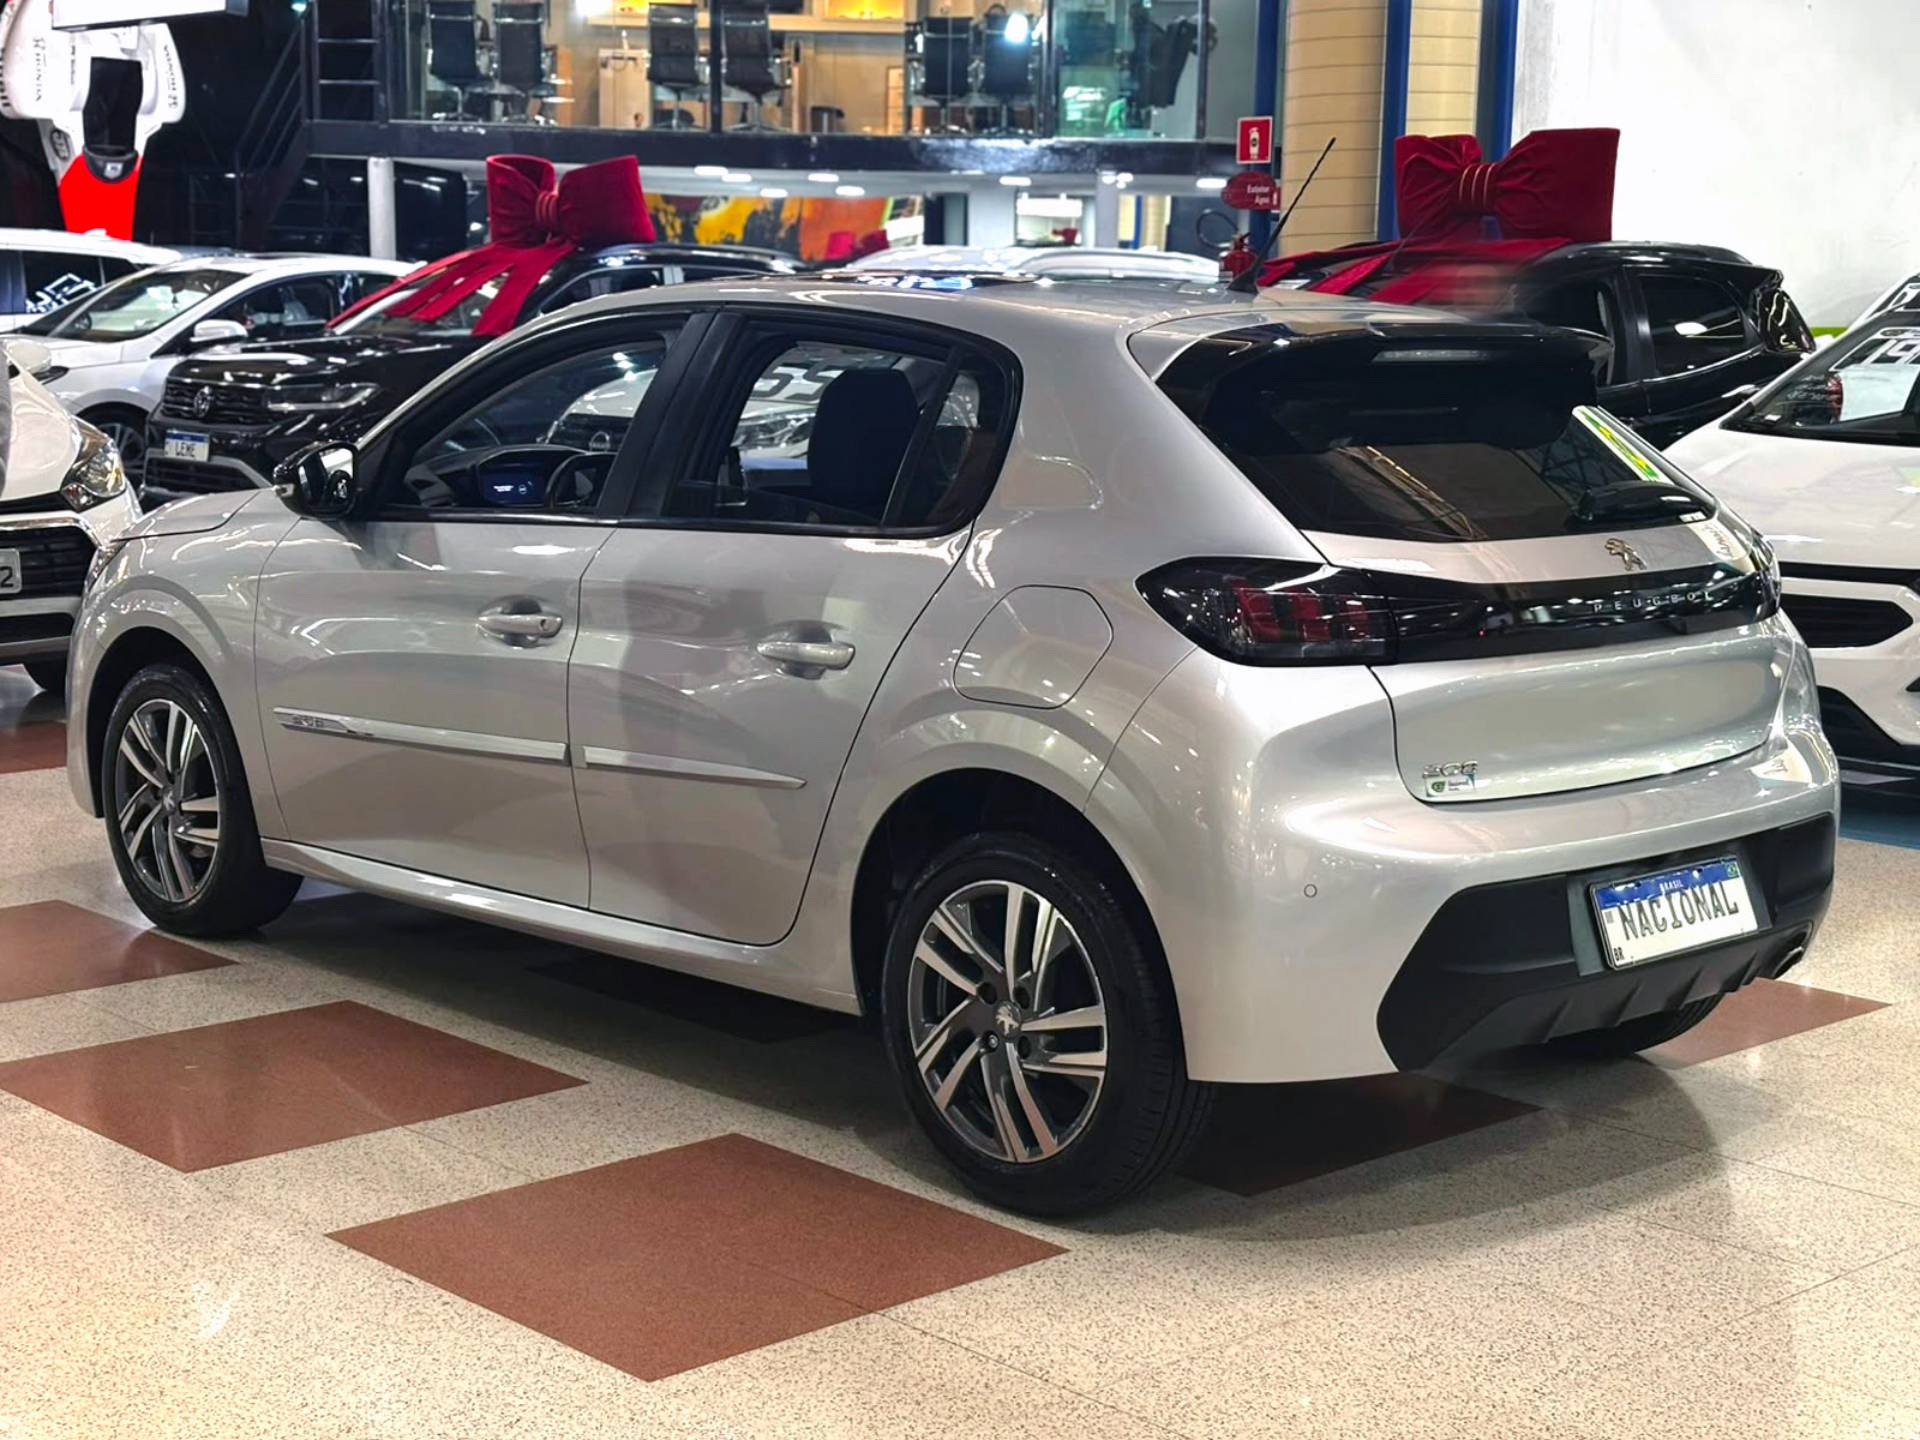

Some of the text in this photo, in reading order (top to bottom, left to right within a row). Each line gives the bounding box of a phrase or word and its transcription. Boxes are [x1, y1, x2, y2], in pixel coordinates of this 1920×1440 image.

[1659, 879, 1684, 893] BRASIL
[1616, 881, 1740, 941] NACIONAL
[1612, 946, 1625, 962] BR
